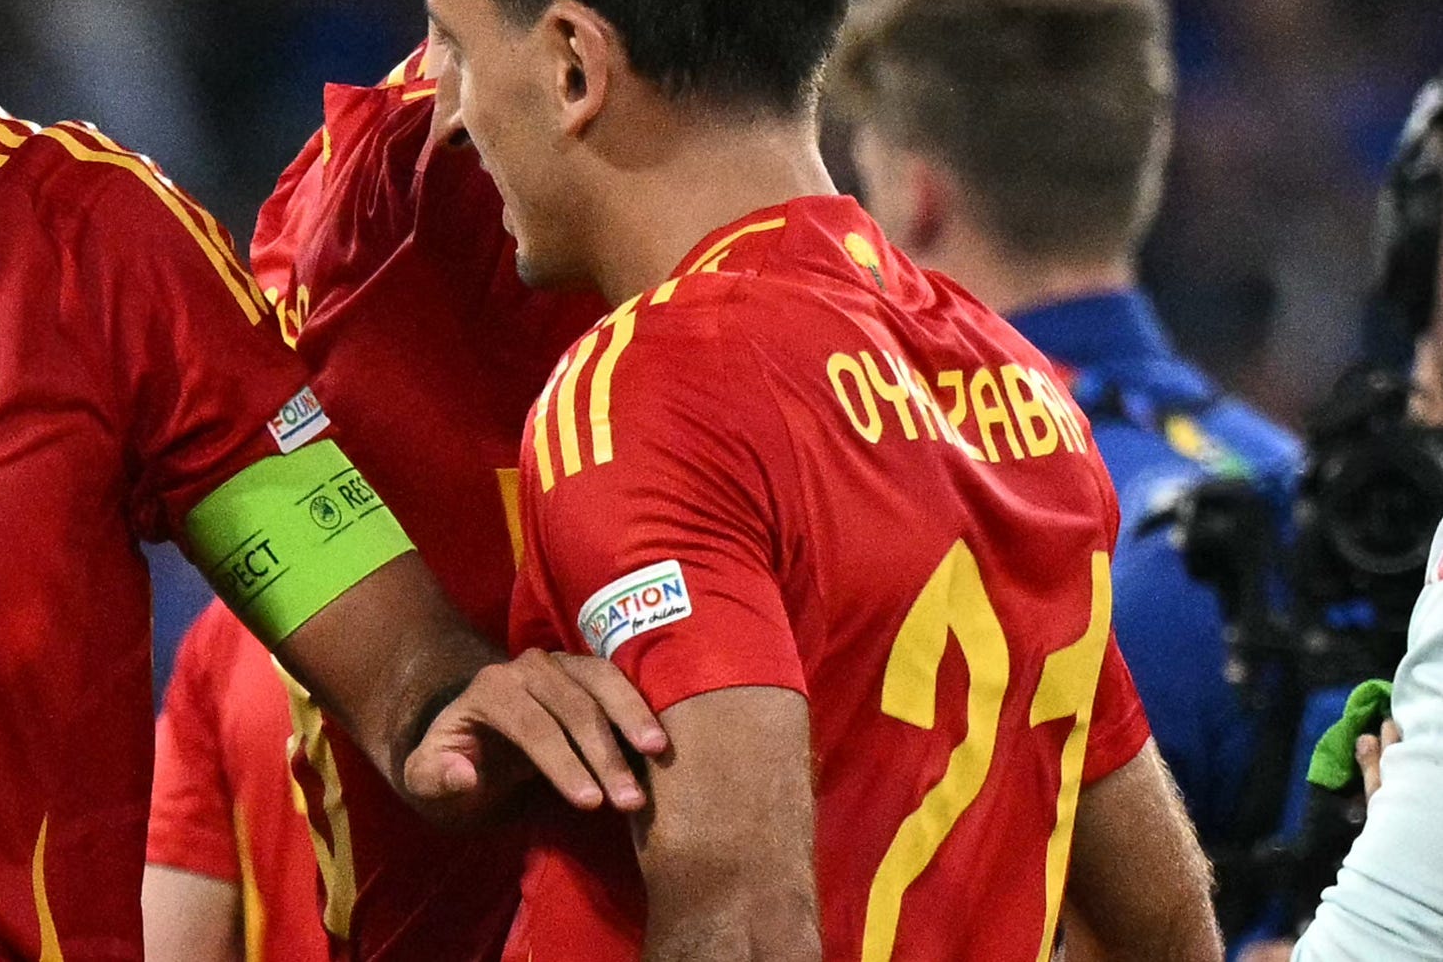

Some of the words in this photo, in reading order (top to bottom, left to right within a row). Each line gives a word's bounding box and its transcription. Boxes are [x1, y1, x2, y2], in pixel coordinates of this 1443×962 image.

[632, 616, 646, 635] for
[648, 605, 686, 624] children
[861, 538, 1111, 962] 21
